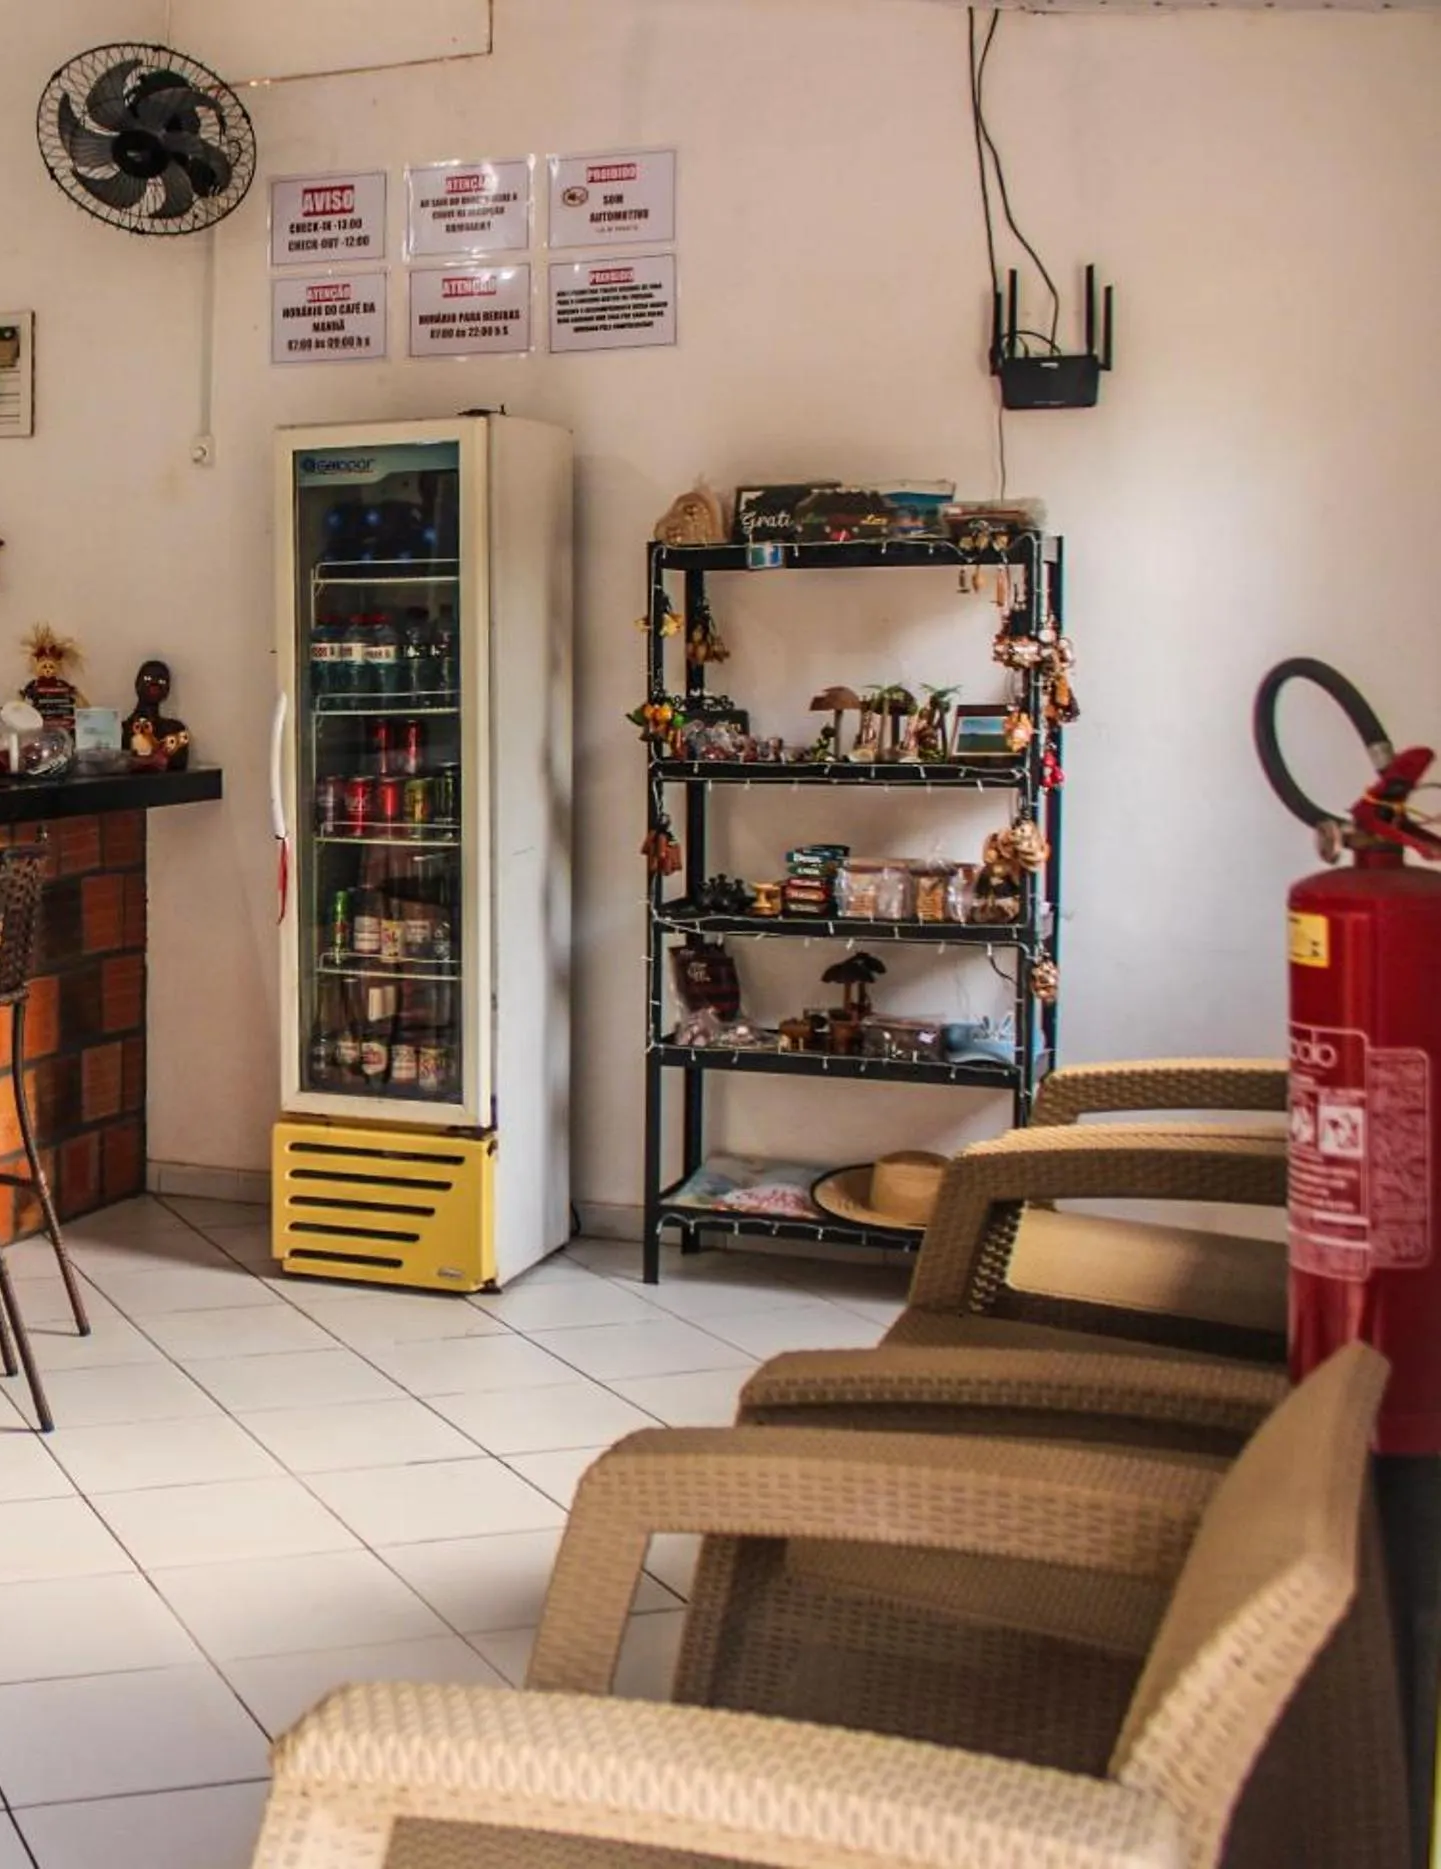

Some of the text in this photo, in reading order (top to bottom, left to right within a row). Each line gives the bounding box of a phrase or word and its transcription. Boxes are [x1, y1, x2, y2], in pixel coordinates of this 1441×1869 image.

[446, 175, 494, 193] ATENÇÃ
[303, 189, 354, 214] AVISO
[603, 193, 623, 205] SOM
[289, 220, 332, 234] CHECK-IN
[288, 237, 339, 252] CHECK-OUT
[307, 284, 351, 302] ATENÇÃO
[282, 302, 376, 318] HORÁRIO DO CAFÉ DA
[312, 319, 345, 332] MANHÃ
[742, 511, 792, 534] Grati
